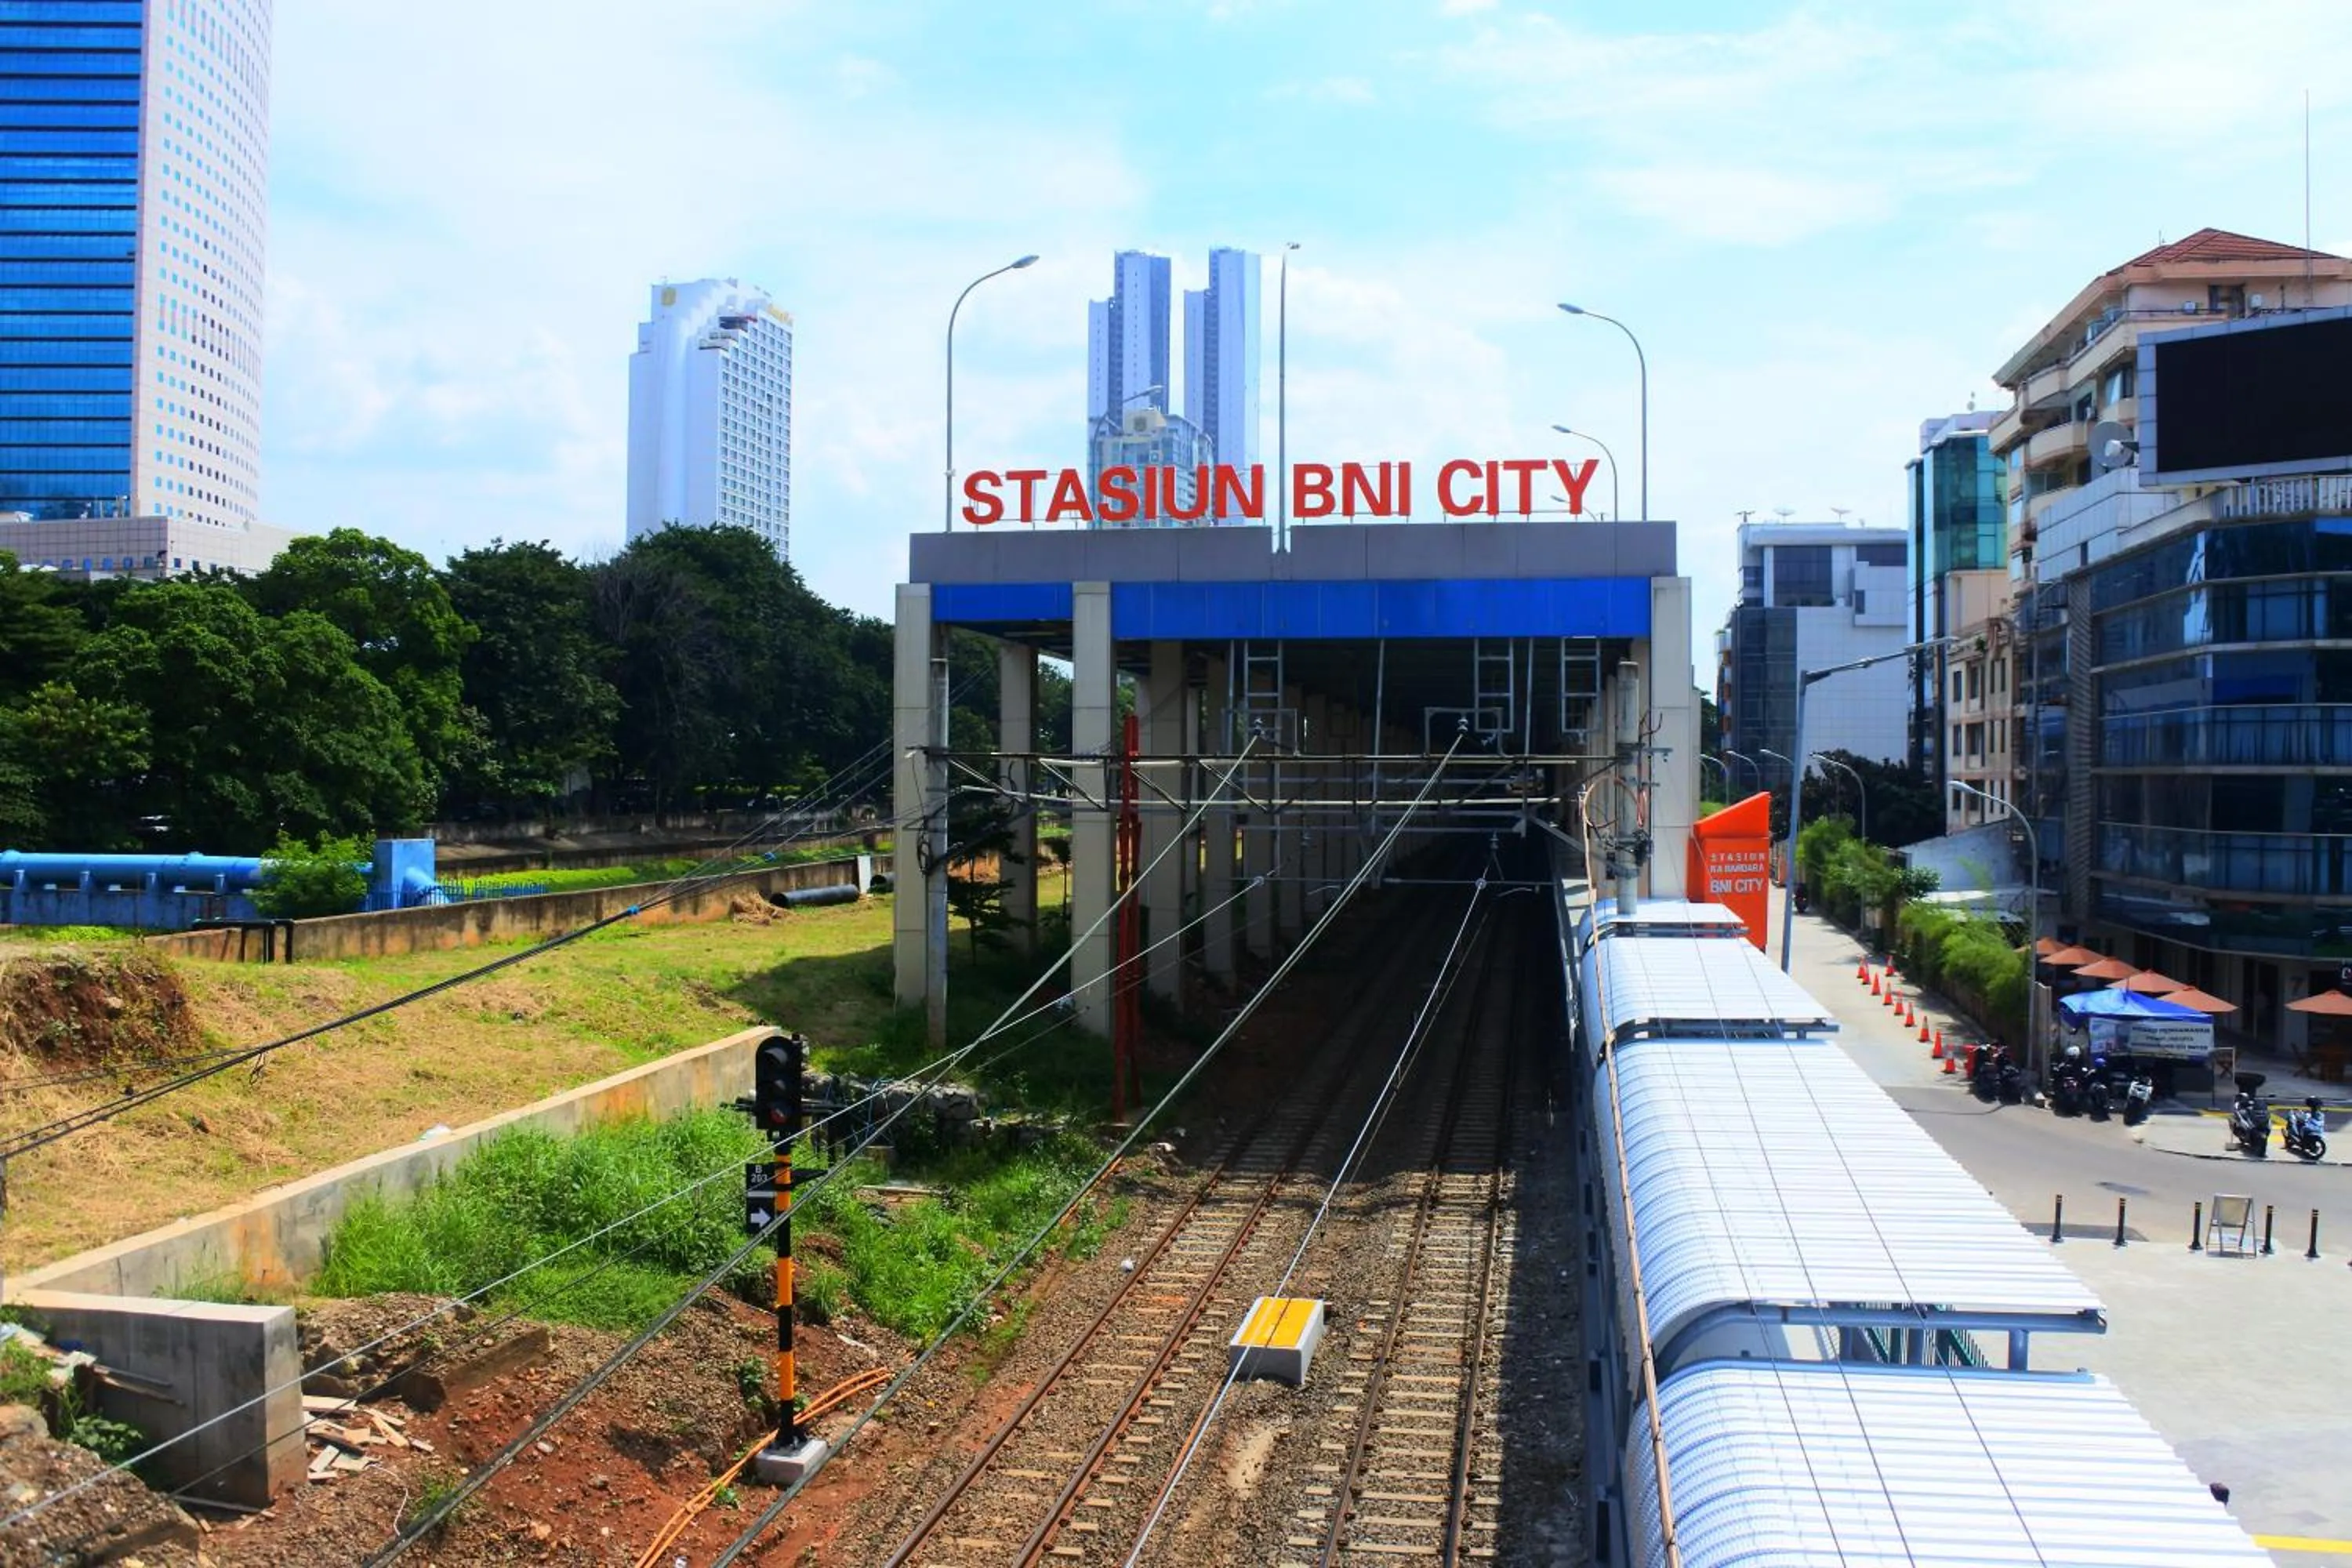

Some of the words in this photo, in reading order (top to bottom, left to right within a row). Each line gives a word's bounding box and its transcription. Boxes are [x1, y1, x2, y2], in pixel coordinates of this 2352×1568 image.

[962, 464, 1264, 524] STASIUN
[1293, 461, 1410, 517] BNI
[1437, 459, 1600, 517] CITY
[1711, 852, 1765, 862] STASIUN
[1711, 879, 1732, 892] BNI
[1735, 878, 1763, 892] CITY
